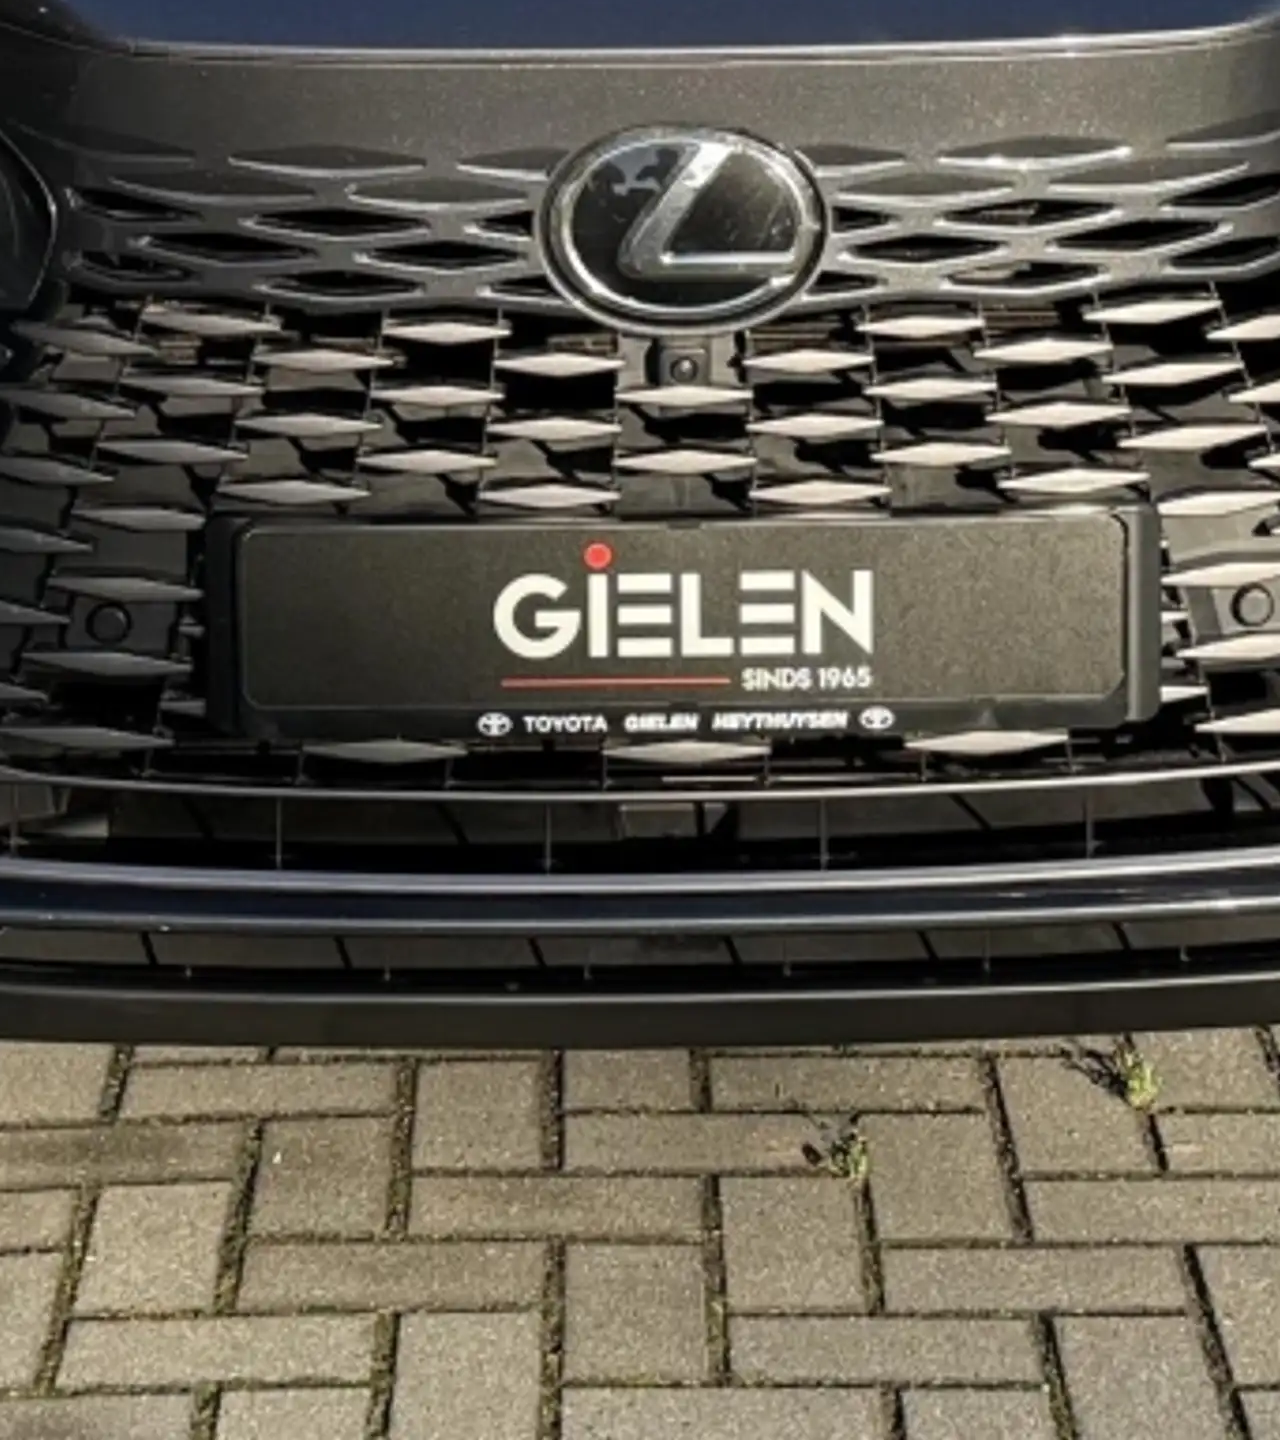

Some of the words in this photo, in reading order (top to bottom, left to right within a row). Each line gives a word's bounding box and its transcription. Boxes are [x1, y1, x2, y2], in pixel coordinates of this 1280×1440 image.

[741, 666, 812, 691] SINDS
[817, 664, 874, 689] 1965
[523, 715, 608, 733] TOYOTA
[624, 712, 700, 731] GIELEN
